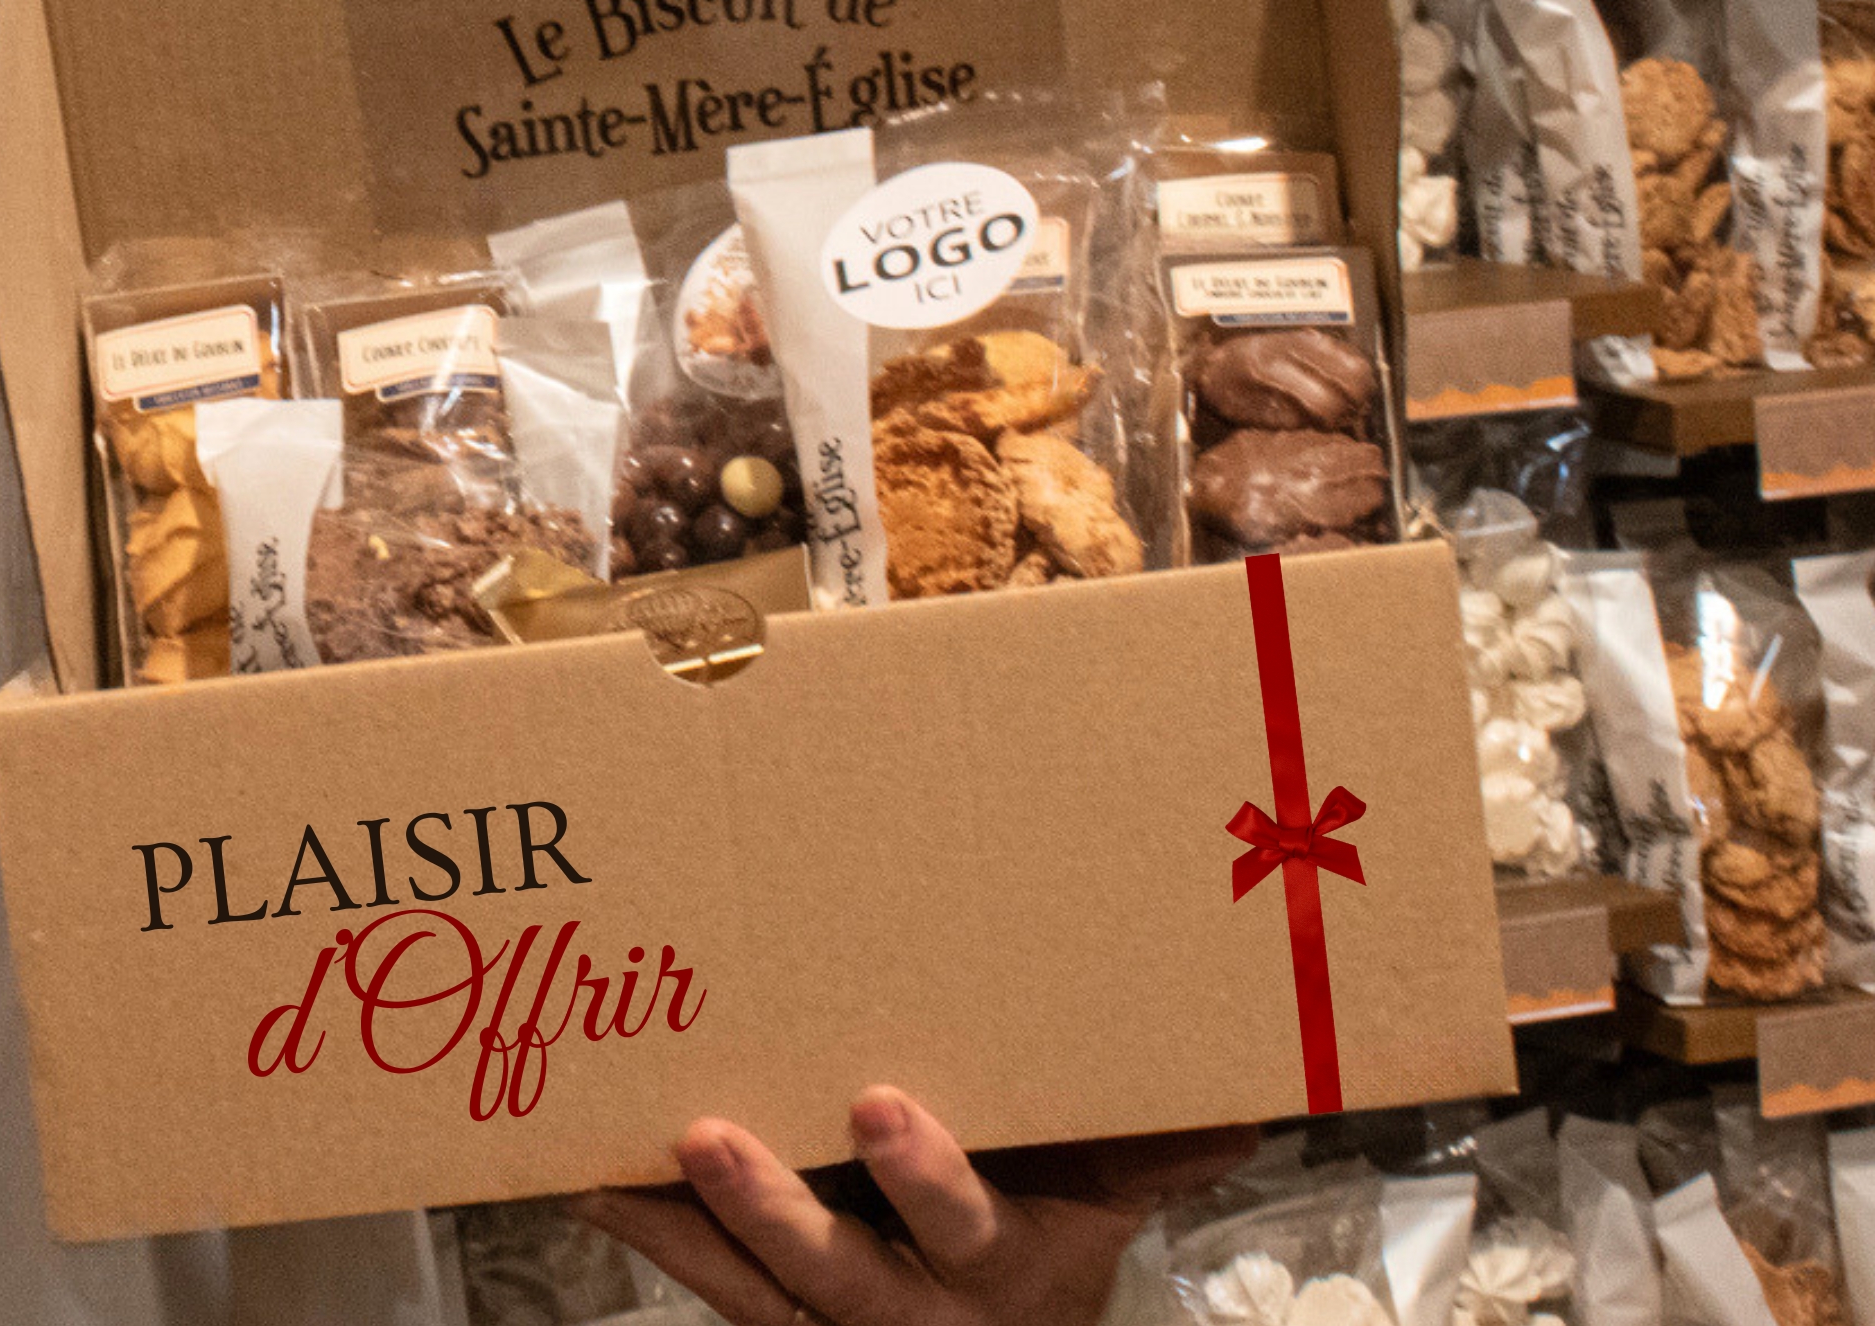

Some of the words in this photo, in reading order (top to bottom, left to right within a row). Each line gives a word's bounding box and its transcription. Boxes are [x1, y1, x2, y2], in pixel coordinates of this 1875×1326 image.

[494, 14, 569, 88] Le
[455, 45, 976, 179] Sainte-Mère-Église
[833, 213, 1025, 294] LOGO
[860, 191, 984, 244] VOTRE
[914, 273, 962, 304] ICI
[131, 800, 593, 932] PLAISIR
[247, 908, 708, 1122] d'Offrir
